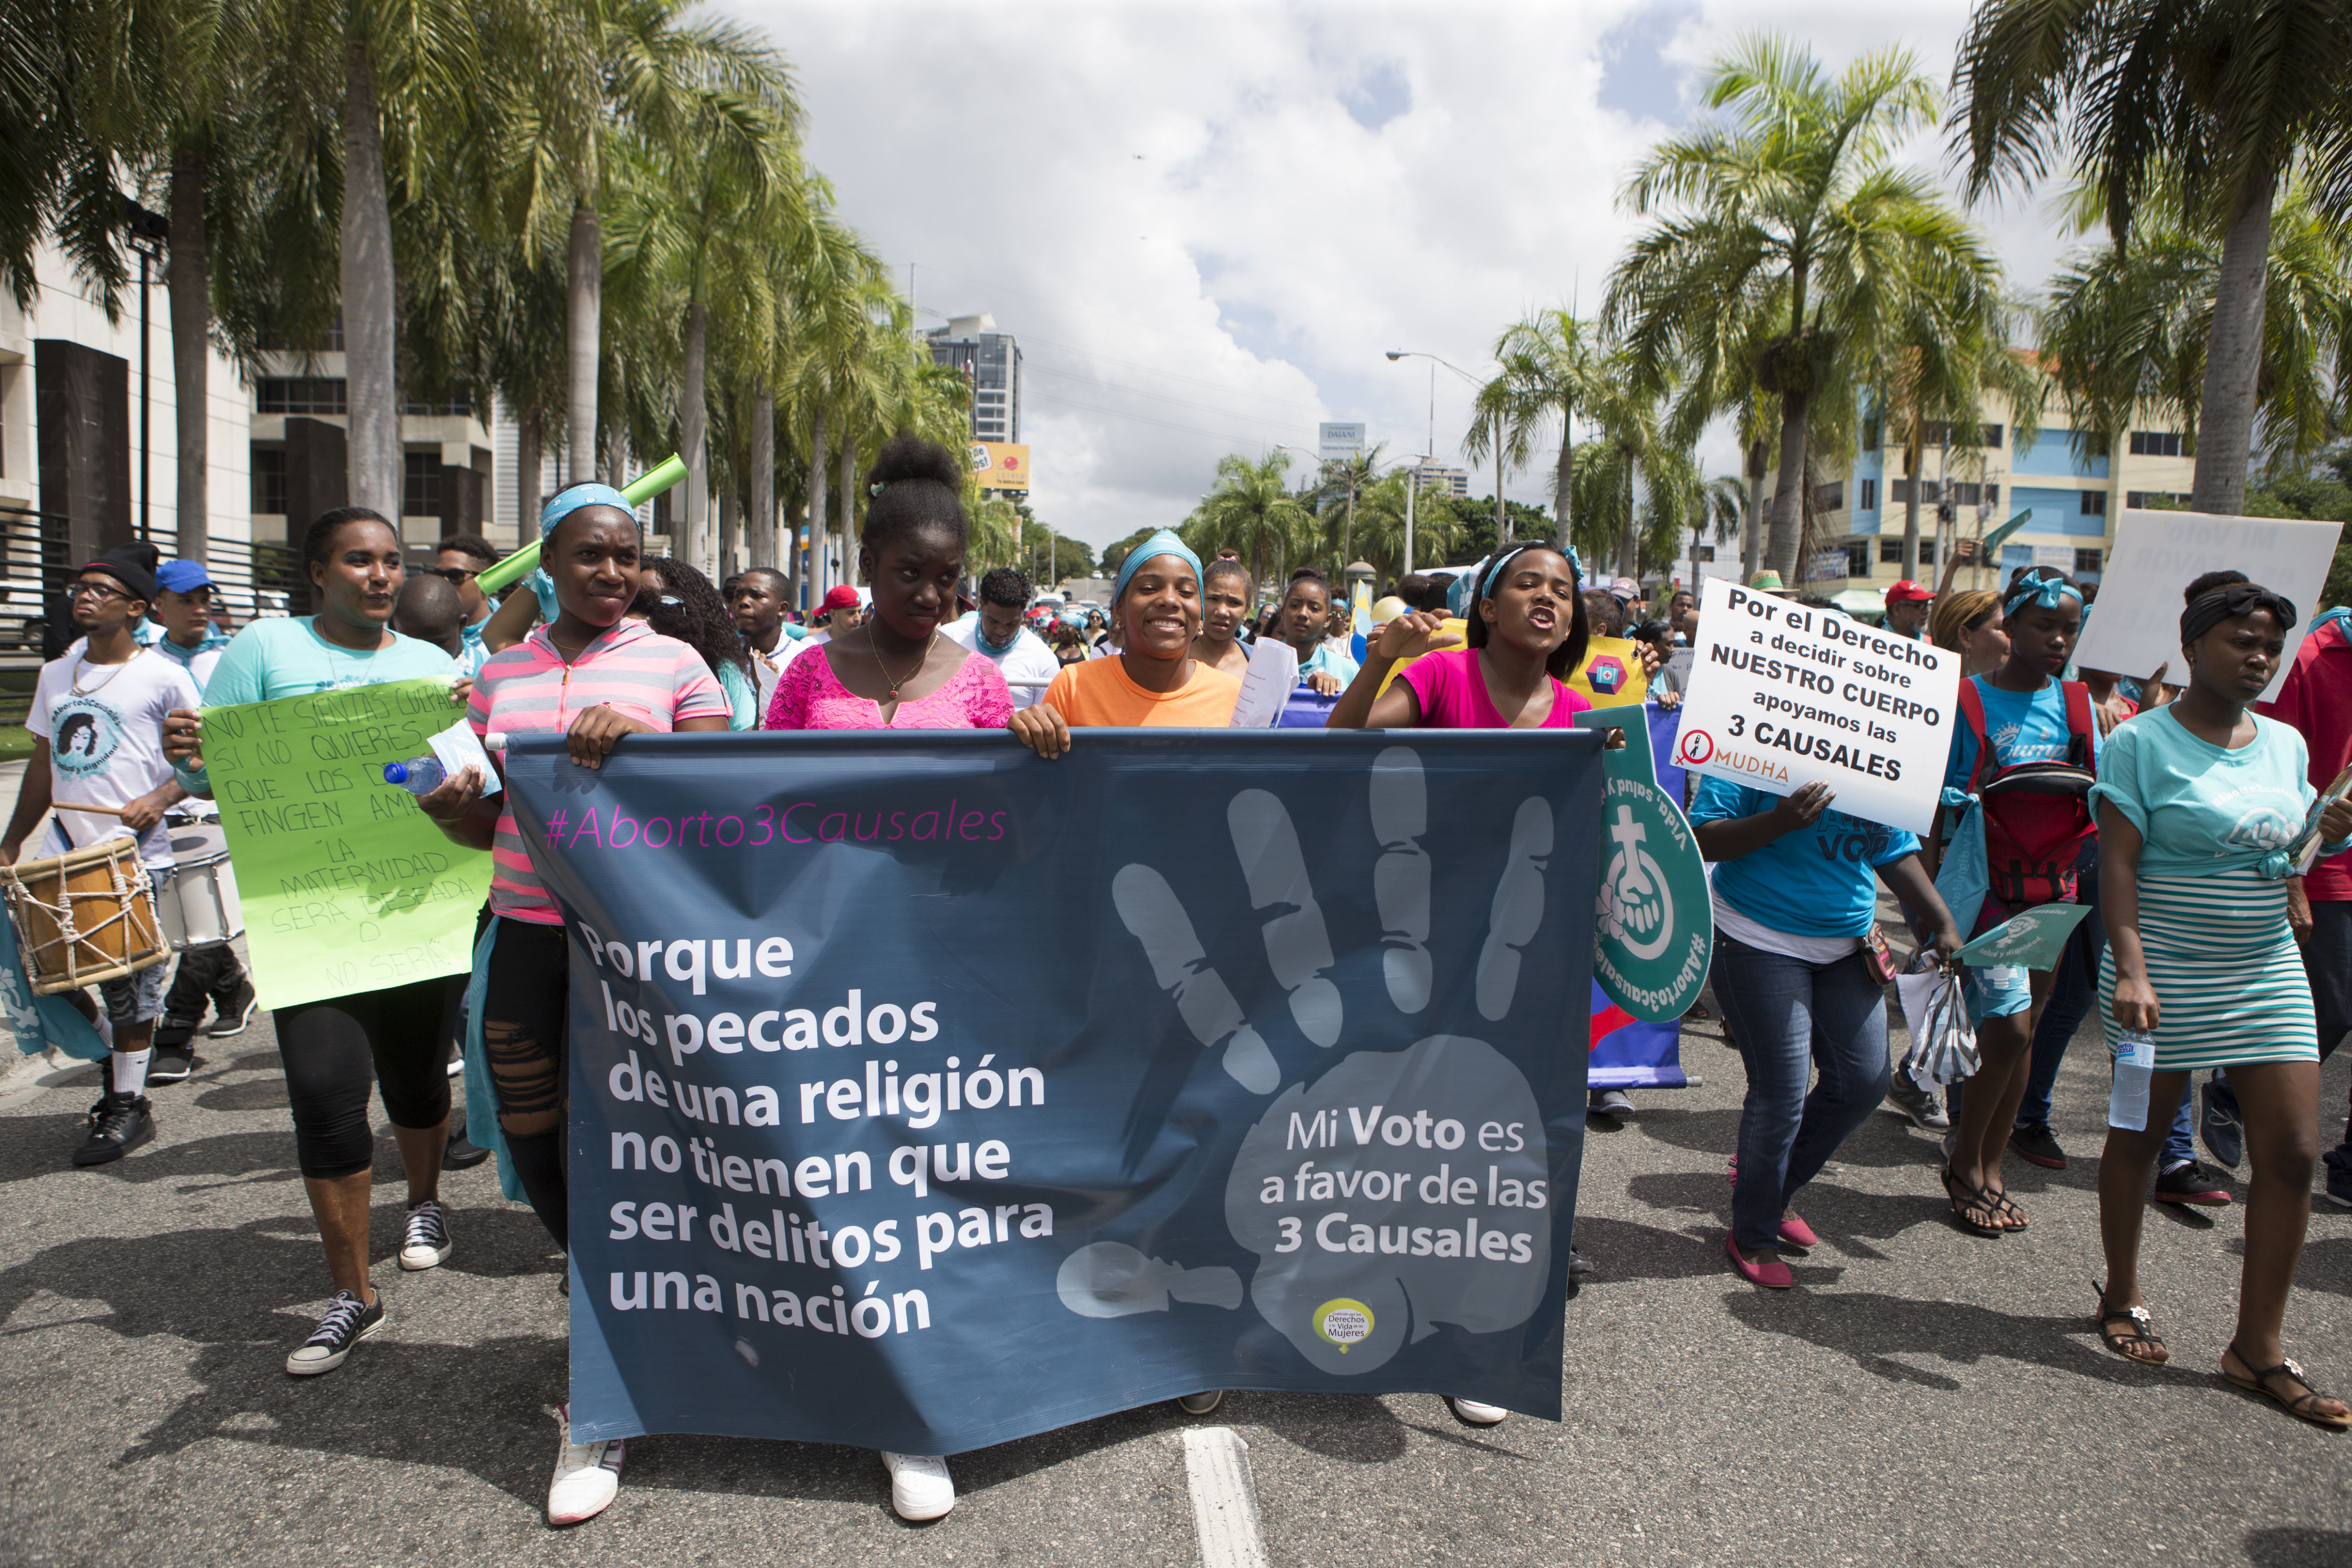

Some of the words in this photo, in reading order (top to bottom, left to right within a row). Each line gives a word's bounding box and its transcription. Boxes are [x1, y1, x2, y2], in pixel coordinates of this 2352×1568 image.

[1729, 589, 1778, 621] Por
[1787, 612, 1812, 632] el
[1823, 617, 1938, 670] Derecho
[1711, 643, 1834, 695] NUESTRO
[1843, 683, 1939, 726] CUERPO
[1750, 631, 1763, 644] a
[1771, 634, 1847, 668] decidir
[1853, 661, 1911, 688] sobre
[202, 711, 244, 742] NO
[246, 704, 286, 734] TE
[293, 691, 391, 729] SIENTAS
[1753, 692, 1860, 732] apoyamos
[1868, 720, 1897, 743] las
[83, 744, 120, 772] dignidad
[214, 746, 244, 772] SI
[256, 739, 292, 765] NO
[311, 721, 422, 761] QUIERES
[1715, 747, 1788, 783] MUDHA
[1728, 715, 1745, 737] 3
[1755, 722, 1901, 781] CAUSALES
[225, 779, 285, 804] QUE
[306, 768, 354, 794] LOS
[1607, 776, 1615, 796] y
[1616, 779, 1653, 803] salud
[238, 800, 344, 836] FINGEN
[544, 798, 1007, 850] #Aborto3Causales
[1656, 795, 1687, 852] Vida,
[280, 852, 449, 899] MATERNIDAD
[271, 894, 351, 934] SERÁ
[358, 877, 475, 915] DESEADA
[578, 920, 795, 996] Porque
[1979, 947, 1998, 957] salud
[2006, 936, 2043, 956] dignidad
[325, 960, 358, 989] NO
[600, 980, 658, 1046] los
[664, 988, 939, 1067] pecados
[2118, 1045, 2134, 1054] azul
[609, 1049, 670, 1108] de
[673, 1081, 780, 1127] una
[800, 1054, 1045, 1129] religión
[1286, 1109, 1338, 1151] Mi
[1347, 1105, 1466, 1151] Voto
[1478, 1121, 1525, 1153] es
[611, 1131, 682, 1173] no
[689, 1136, 872, 1199] tienen
[888, 1138, 1011, 1199] que
[1260, 1176, 1285, 1204] a
[1294, 1161, 1411, 1202] favor
[1419, 1163, 1478, 1205] de
[1487, 1165, 1547, 1210] las
[609, 1201, 698, 1242] ser
[708, 1202, 902, 1269] delitos
[916, 1202, 1053, 1271] para
[1274, 1216, 1303, 1253] 3
[1315, 1212, 1533, 1264] Causales
[610, 1271, 723, 1313] una
[735, 1279, 931, 1339] nación
[1328, 1329, 1365, 1338] Mujeres
